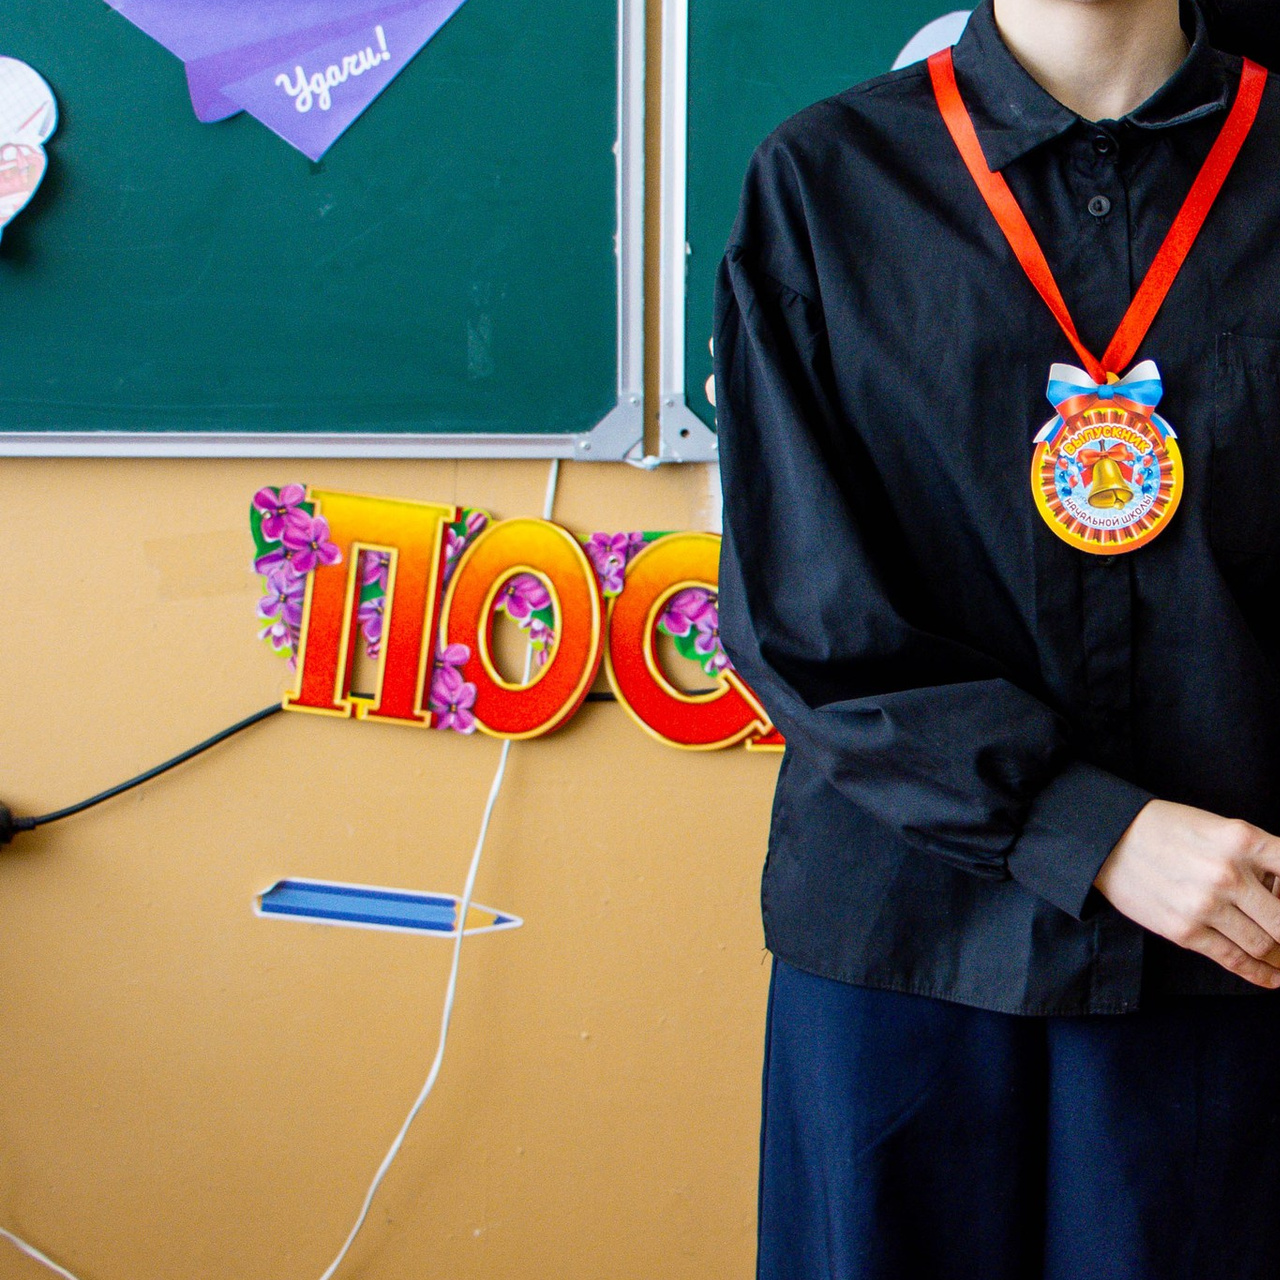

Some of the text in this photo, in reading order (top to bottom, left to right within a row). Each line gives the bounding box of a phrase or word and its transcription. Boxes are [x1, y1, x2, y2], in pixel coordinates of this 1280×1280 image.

[276, 26, 391, 113] Удачи!
[1063, 426, 1151, 455] ВЫПУСКНИК
[1064, 495, 1154, 527] НАЧАЛЬНОЙ ШКОЛЫ
